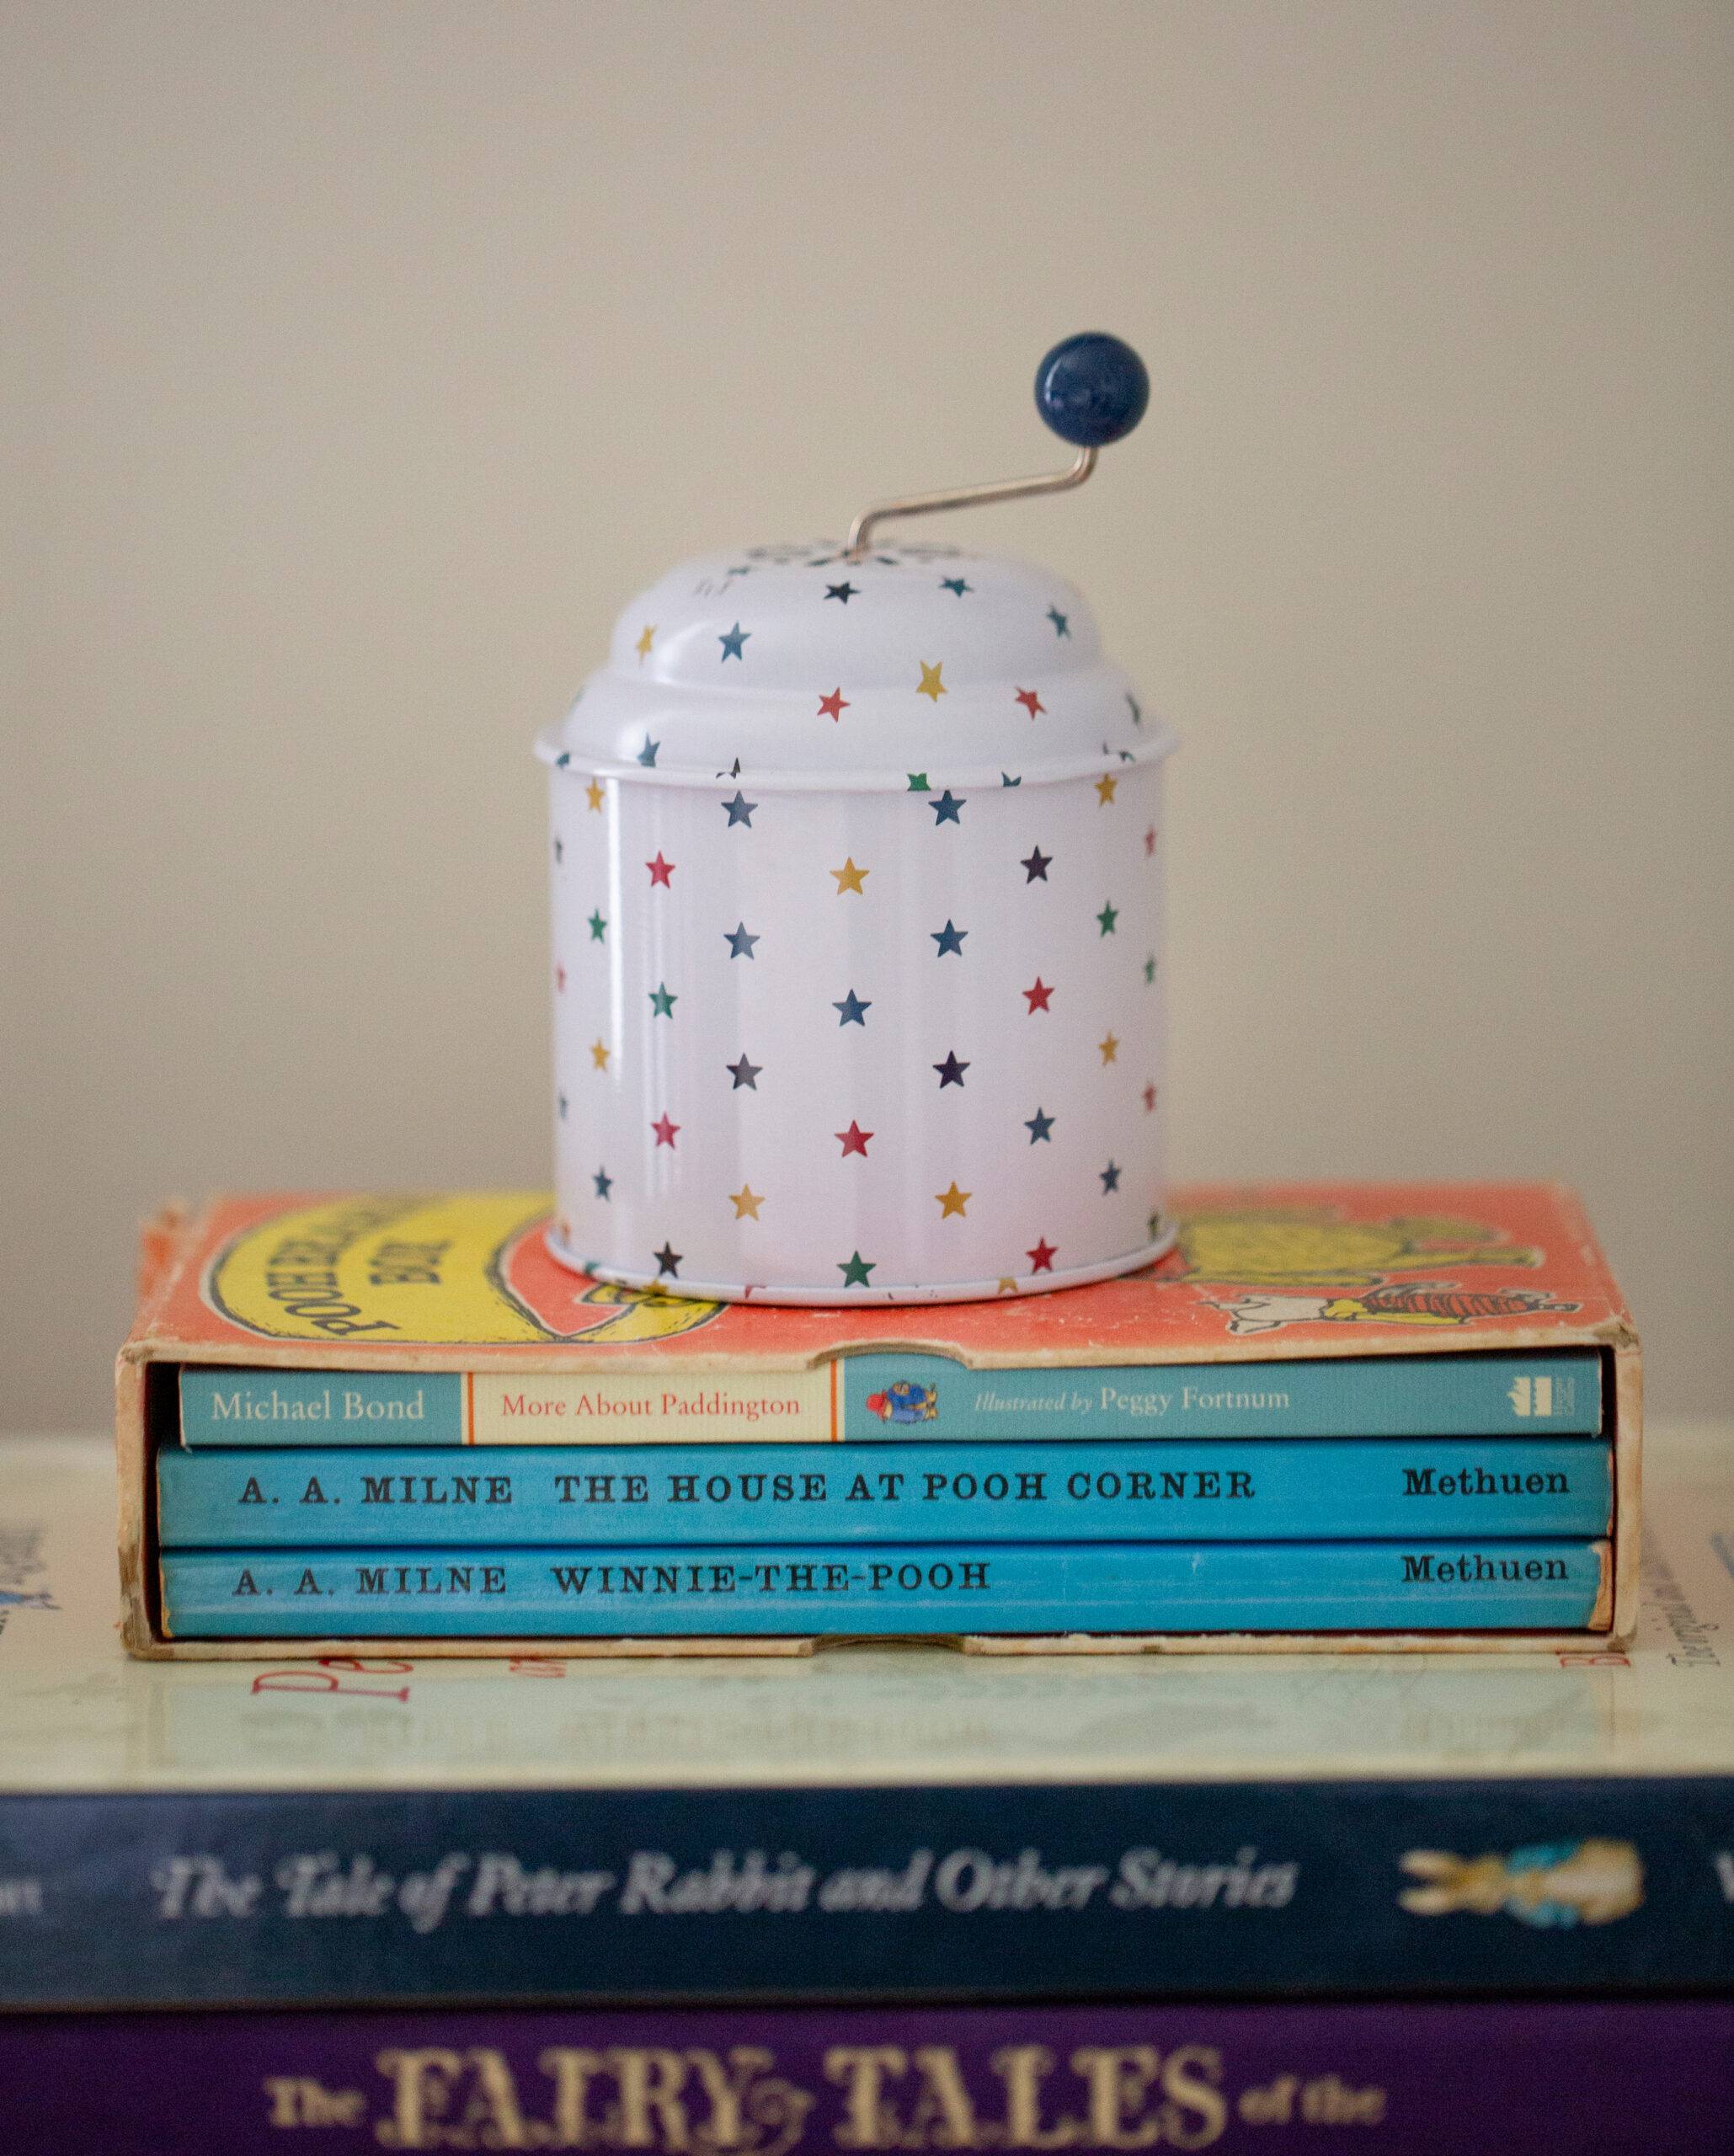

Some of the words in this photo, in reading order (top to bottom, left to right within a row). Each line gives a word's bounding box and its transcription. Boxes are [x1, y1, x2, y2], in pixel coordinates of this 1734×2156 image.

[266, 1270, 399, 1336] POOH
[211, 1389, 332, 1422] Michael
[344, 1389, 425, 1422] Bond
[502, 1393, 567, 1417] More
[575, 1391, 652, 1417] About
[661, 1390, 801, 1422] Paddington
[974, 1391, 1066, 1413] Illustrated
[1070, 1391, 1093, 1416] by
[1100, 1385, 1173, 1416] Peggy
[1182, 1385, 1291, 1412] Fortnum
[238, 1476, 280, 1505] A.
[300, 1476, 341, 1505] A.
[361, 1475, 513, 1504] MILNE
[554, 1474, 649, 1503] THE
[668, 1473, 827, 1503] HOUSE
[846, 1472, 905, 1502] AT
[923, 1471, 1048, 1501] POOH
[1067, 1470, 1256, 1501] CORNER
[1403, 1467, 1570, 1497] Methuen
[232, 1568, 273, 1597] A.
[294, 1567, 335, 1597] A.
[357, 1566, 508, 1595] MILNE
[550, 1562, 992, 1593] WINNIE-THE-POOH
[1401, 1554, 1568, 1583] Methuen
[153, 1853, 261, 1917] The
[275, 1853, 396, 1917] Tale
[399, 1853, 470, 1935] of
[468, 1852, 615, 1917] Peter
[620, 1851, 814, 1915] Rabbit
[818, 1850, 933, 1913] and
[935, 1849, 1107, 1912] Other
[1110, 1847, 1300, 1910] Stories
[376, 2047, 804, 2153] FAIRY
[824, 2045, 1228, 2151] TALES
[1239, 2075, 1298, 2124] of
